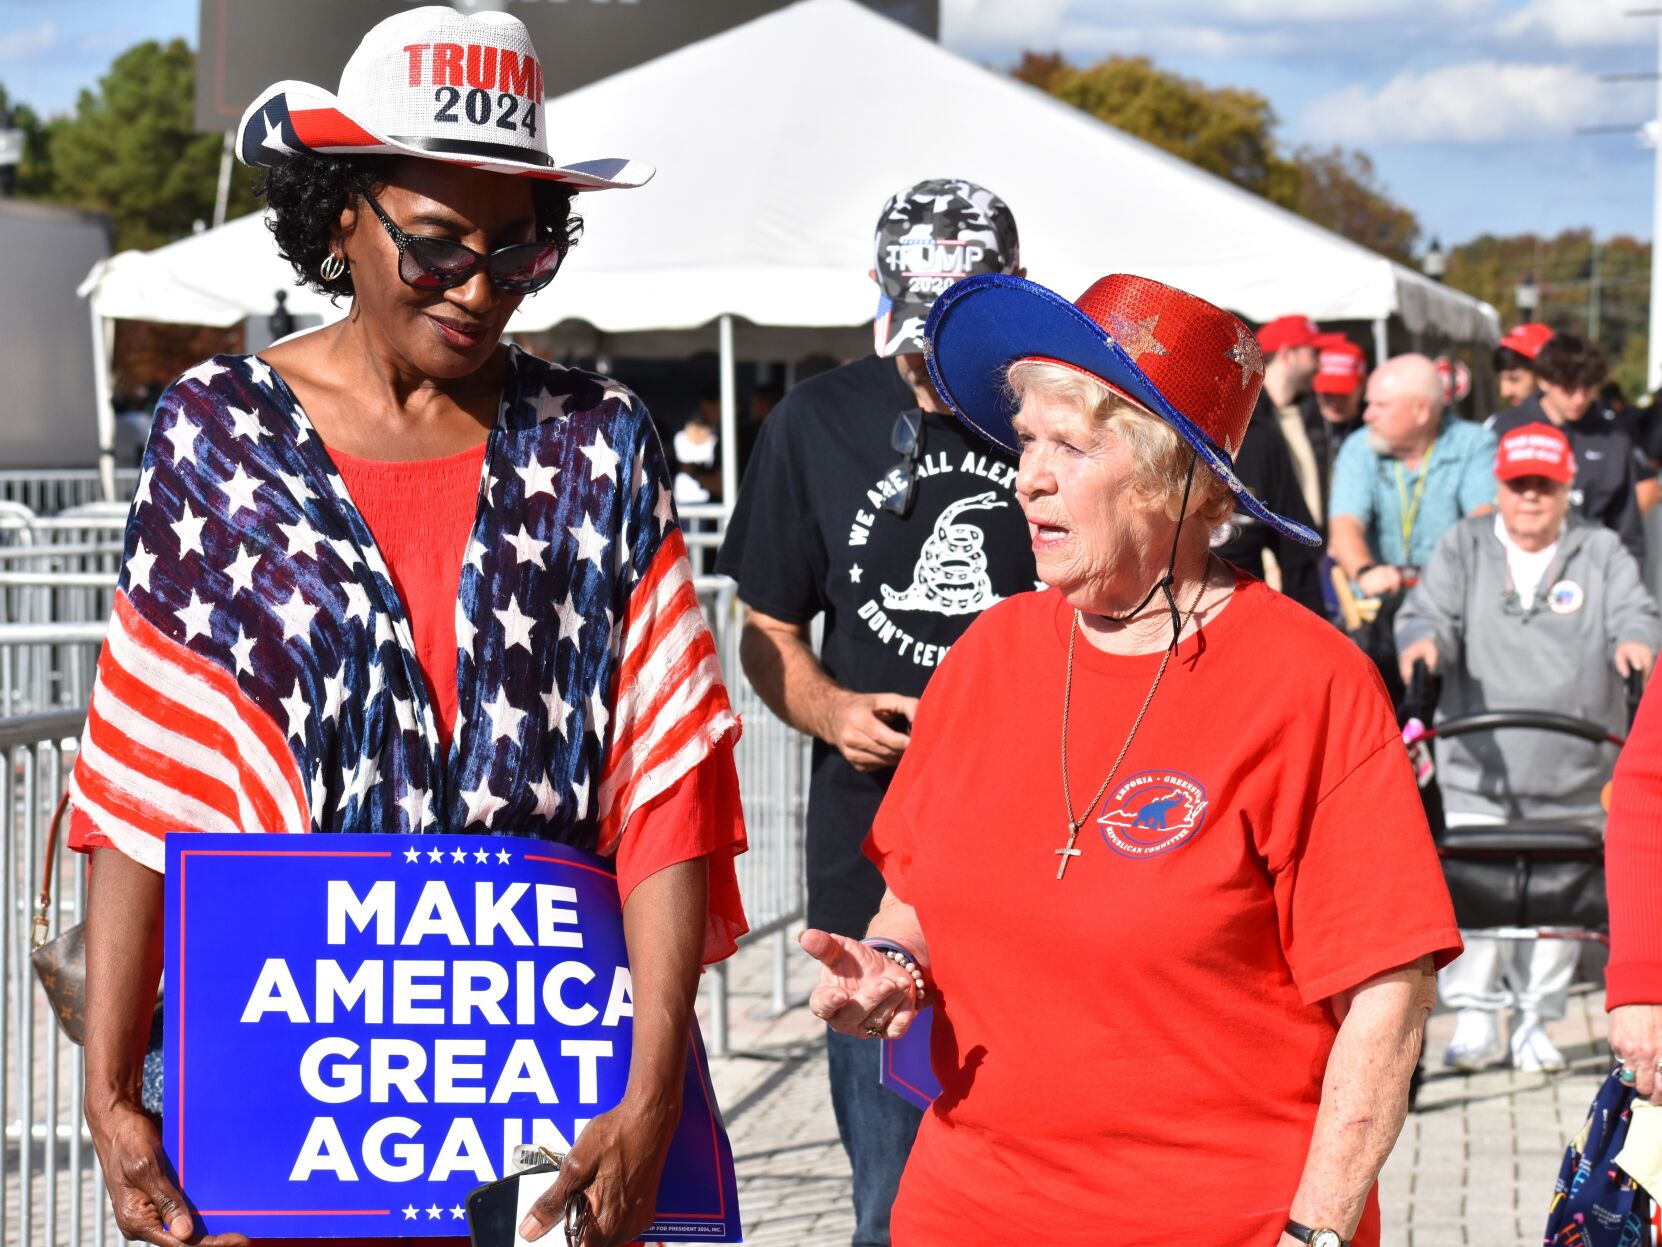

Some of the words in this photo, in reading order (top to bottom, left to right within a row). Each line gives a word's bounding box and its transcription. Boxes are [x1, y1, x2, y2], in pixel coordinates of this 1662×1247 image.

[434, 86, 537, 138] 2024
[886, 244, 984, 273] TRUMP
[908, 276, 955, 296] 2020
[848, 508, 876, 547] WE
[866, 468, 909, 510] ARE
[915, 451, 954, 481] ALL
[960, 450, 1018, 490] ALEX
[857, 599, 914, 657] DON'T
[1115, 776, 1153, 801] EMPORIA
[327, 880, 583, 949] MAKE
[240, 958, 634, 1027] AMERICA
[300, 1036, 613, 1105] GREAT
